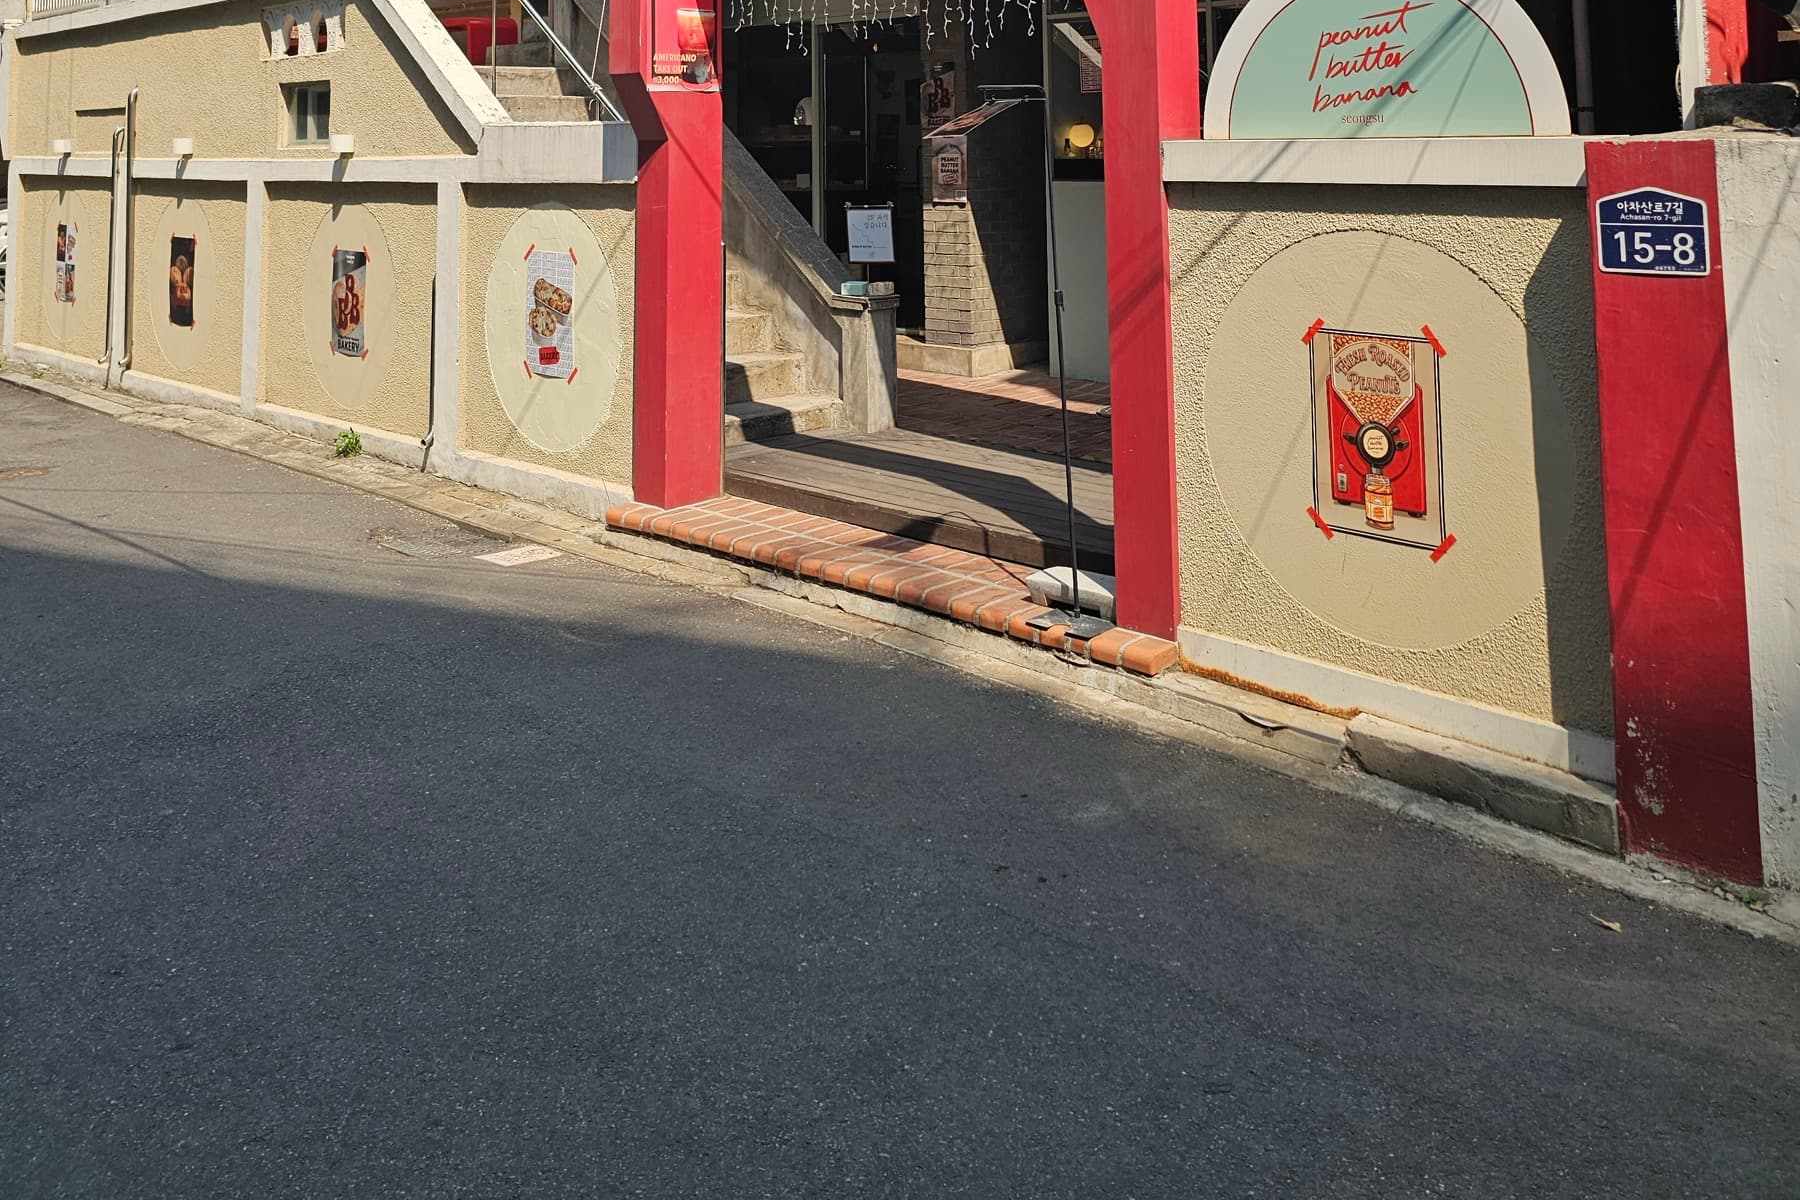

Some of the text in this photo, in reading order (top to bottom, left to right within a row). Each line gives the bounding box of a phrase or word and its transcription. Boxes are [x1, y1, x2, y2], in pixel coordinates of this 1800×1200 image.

[1308, 0, 1435, 81] peanut
[653, 53, 697, 63] AMERICANO
[653, 64, 688, 74] TAKE OUT
[1325, 41, 1415, 79] butter
[1312, 81, 1418, 113] banana
[1341, 113, 1384, 127] seongsu
[1620, 213, 1682, 223] Achasan-ro 7-gil
[1614, 231, 1695, 265] 15-8
[338, 338, 360, 353] BAKERY
[1367, 343, 1411, 382] ROASTED
[1347, 373, 1401, 395] PEANUTS
